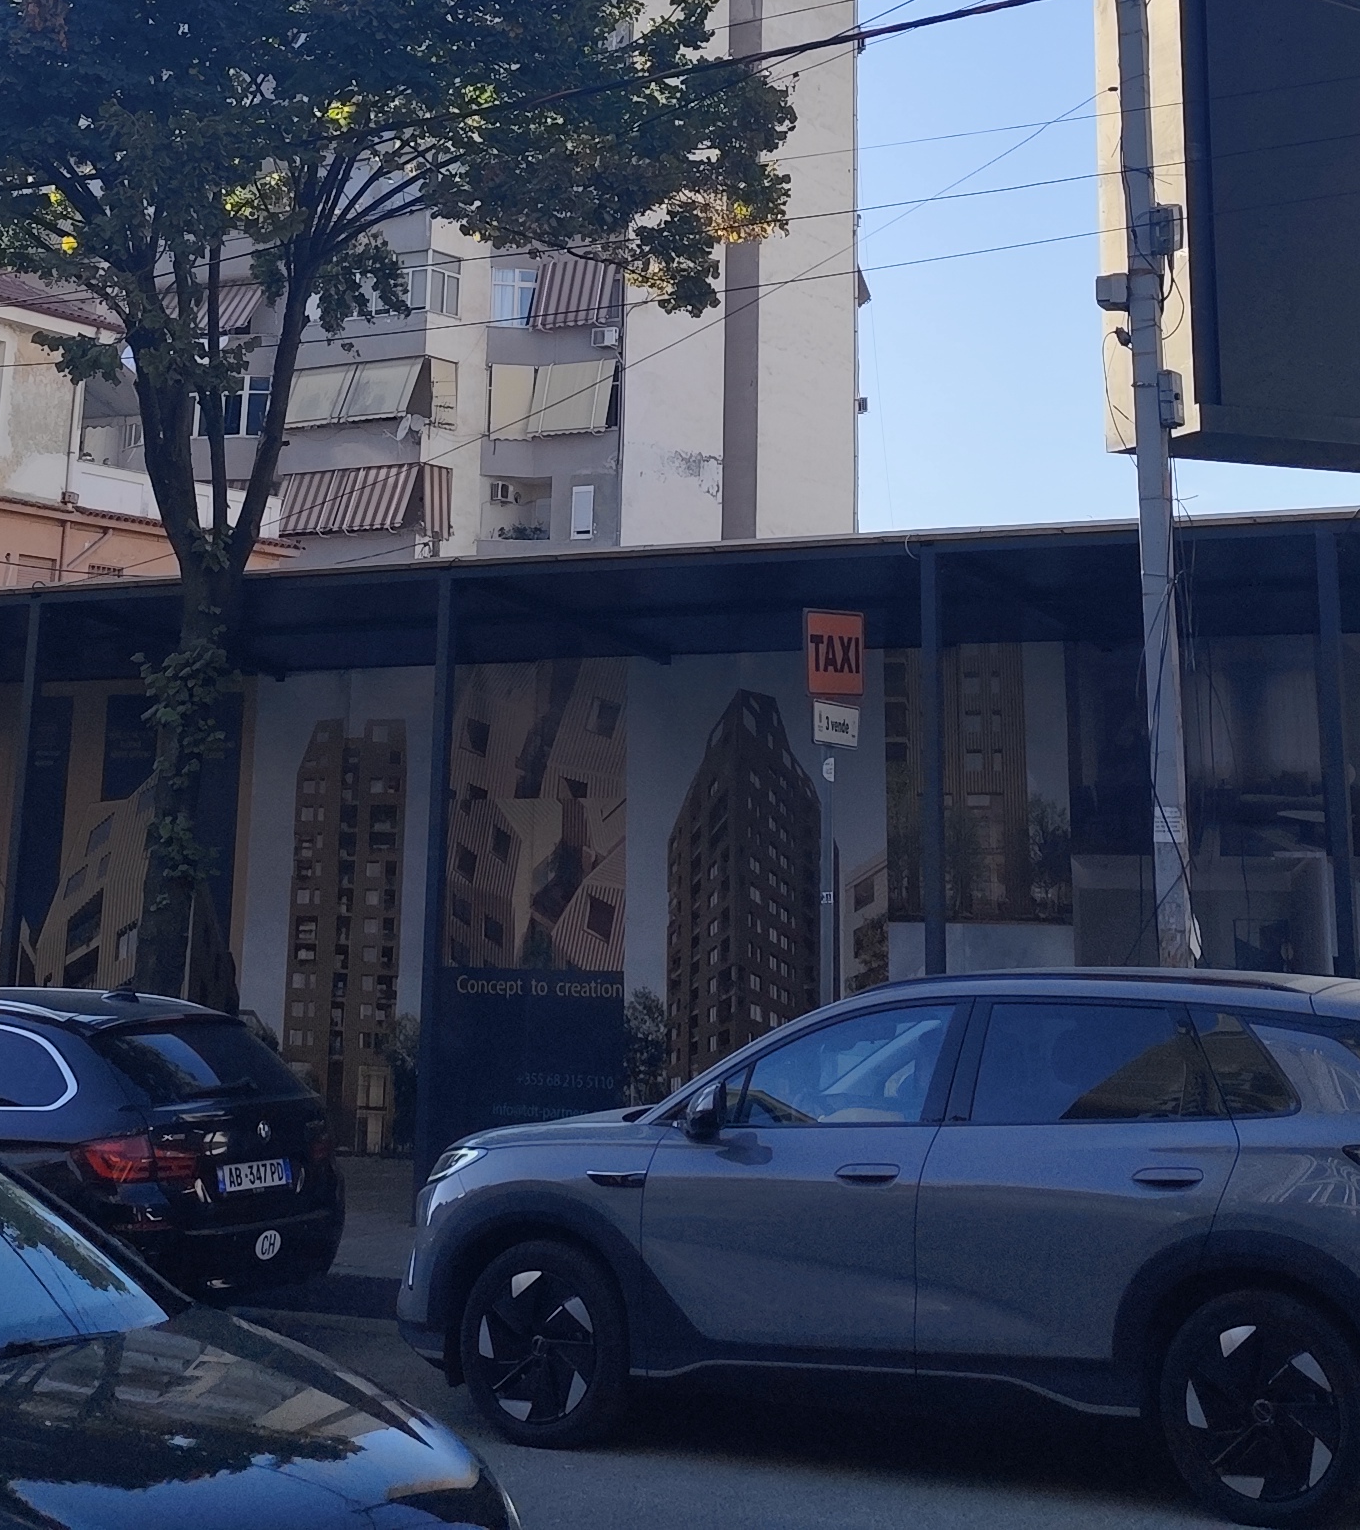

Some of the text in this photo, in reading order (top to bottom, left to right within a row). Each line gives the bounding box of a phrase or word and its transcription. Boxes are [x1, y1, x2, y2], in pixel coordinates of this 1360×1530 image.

[809, 634, 860, 674] TAXI
[825, 716, 830, 731] 3
[831, 719, 850, 735] vende
[456, 974, 623, 999] Concept to creation
[516, 1073, 543, 1086] +355
[228, 1161, 284, 1188] AB 347 PD
[260, 1233, 277, 1256] CH
